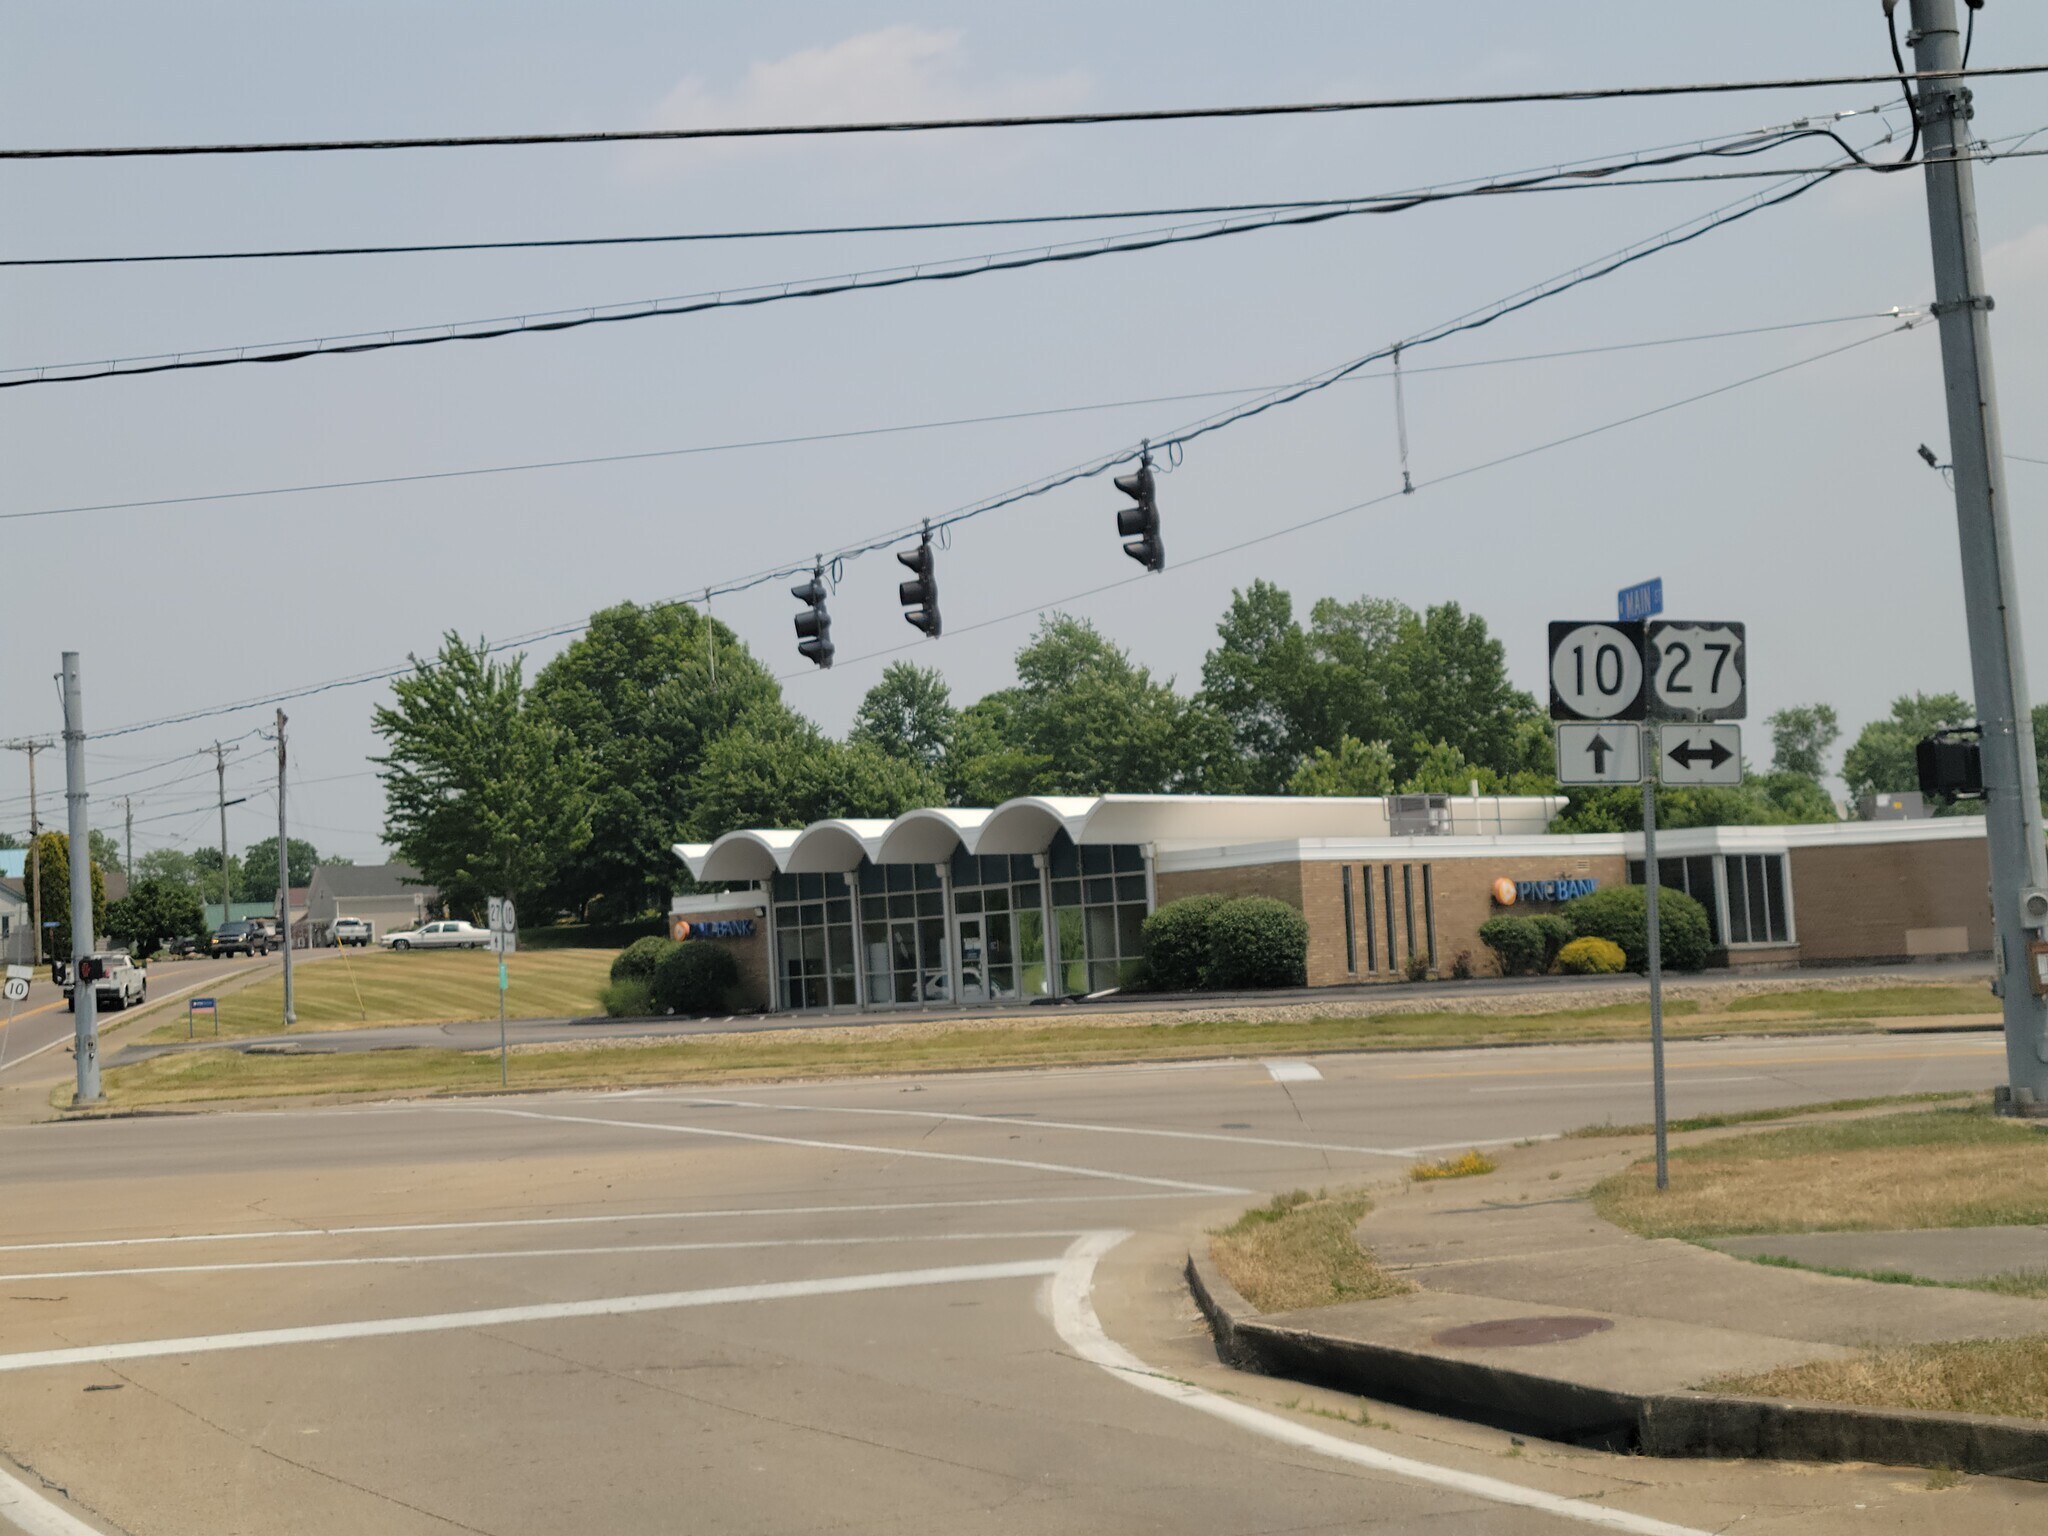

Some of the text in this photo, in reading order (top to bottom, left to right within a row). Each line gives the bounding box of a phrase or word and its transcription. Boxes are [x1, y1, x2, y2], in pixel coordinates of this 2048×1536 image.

[1626, 585, 1651, 619] MAIN
[1573, 643, 1623, 696] 10
[1664, 642, 1731, 694] 27
[1520, 881, 1555, 902] PNC
[491, 905, 500, 922] 27
[10, 983, 24, 995] 10
